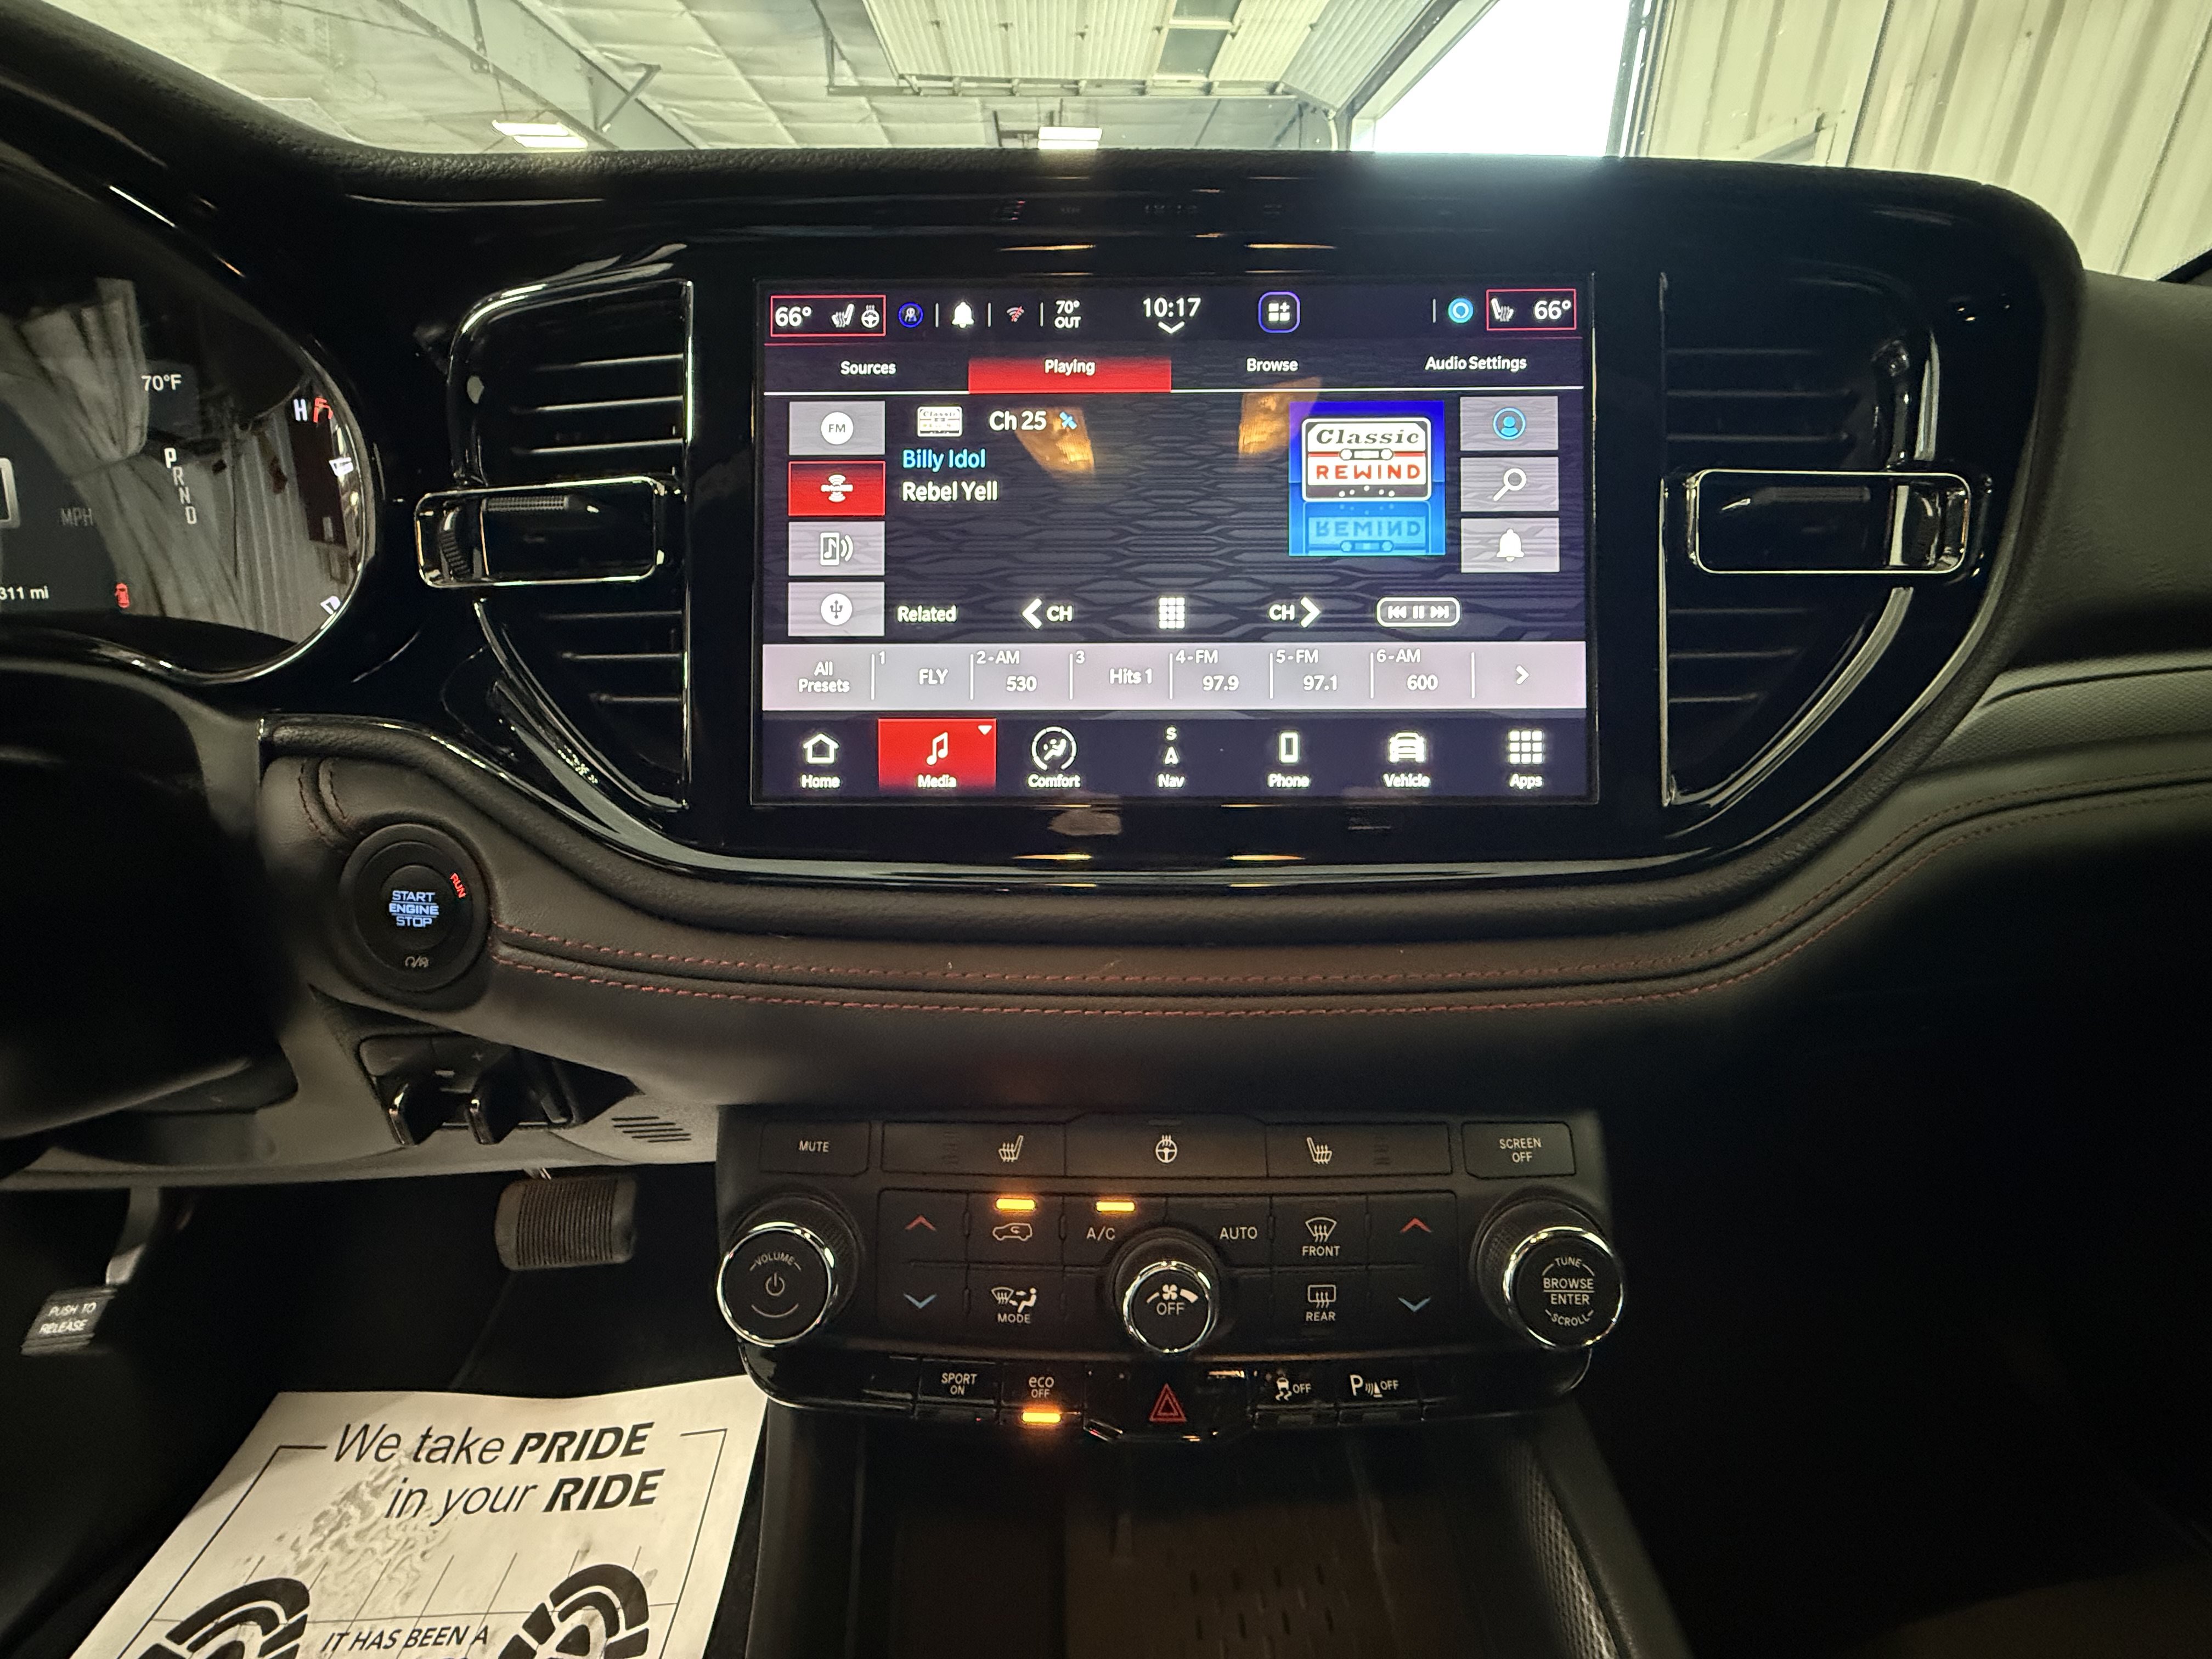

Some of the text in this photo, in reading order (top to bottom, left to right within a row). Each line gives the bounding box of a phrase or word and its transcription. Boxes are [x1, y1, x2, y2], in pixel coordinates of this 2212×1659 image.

[1056, 300, 1080, 314] 70°
[1143, 297, 1201, 317] 10:17
[1534, 300, 1571, 320] 66°
[775, 306, 812, 326] 66°
[1054, 316, 1081, 329] OUT
[840, 360, 896, 375] Sources
[1045, 358, 1095, 376] Playing
[1246, 358, 1298, 371] Browse
[1425, 356, 1527, 372] Audio Settings
[140, 374, 182, 391] 70°F
[989, 410, 1046, 431] Ch 25
[828, 424, 845, 433] FM
[1316, 429, 1419, 444] Classic
[903, 448, 985, 472] Billy Idol
[1316, 464, 1421, 479] REWIND
[902, 481, 998, 501] Rebel Yell
[60, 507, 93, 527] MPH
[30, 585, 49, 600] mi
[898, 605, 956, 622] Related
[1047, 605, 1073, 622] CH
[1269, 605, 1295, 620] CH
[879, 651, 885, 664] 1
[1076, 650, 1085, 664] 3
[814, 661, 833, 676] All
[919, 669, 949, 685] FLY
[1110, 668, 1152, 684] Hits 1
[1203, 675, 1239, 691] 97.9
[1303, 675, 1337, 691] 97.1
[1407, 675, 1438, 690] 600
[798, 678, 850, 692] Presets
[1006, 676, 1037, 692] 530
[1166, 727, 1177, 741] S
[802, 774, 840, 788] Home
[918, 775, 956, 788] Media
[1028, 774, 1081, 788] Comfort
[1158, 774, 1185, 788] Nav
[1269, 774, 1310, 788] Phone
[1383, 773, 1430, 787] Vehicle
[1510, 773, 1543, 789] Apps
[449, 872, 466, 899] RUN
[392, 889, 436, 902] START
[388, 902, 439, 916] ENGINE
[396, 916, 433, 928] STOP
[799, 1140, 829, 1153] MUTE
[1499, 1137, 1542, 1149] SCREEN
[1511, 1152, 1533, 1163] OFF
[1086, 1227, 1115, 1241] A/C
[1220, 1226, 1257, 1240] AUTO
[1302, 1245, 1340, 1257] FRONT
[754, 1251, 795, 1266] VOLUME
[1554, 1257, 1582, 1268] TUNE
[1543, 1277, 1594, 1290] BROWSE
[1550, 1294, 1590, 1306] ENTER
[48, 1302, 97, 1317] PUSH TO
[1156, 1302, 1185, 1316] OFF
[997, 1312, 1031, 1324] MODE
[1306, 1311, 1336, 1322] REAR
[1550, 1312, 1590, 1327] SCROLL
[39, 1319, 88, 1334] RELEASE
[941, 1372, 978, 1385] SPORT
[1029, 1376, 1054, 1388] eco
[1380, 1379, 1400, 1391] OFF
[950, 1385, 965, 1396] ON
[1031, 1389, 1050, 1398] OFF
[1293, 1383, 1312, 1395] OFF
[334, 1421, 655, 1465] We take PRIDE
[385, 1468, 666, 1526] in your RIDE
[321, 1624, 488, 1652] IT HAS BEEN A
